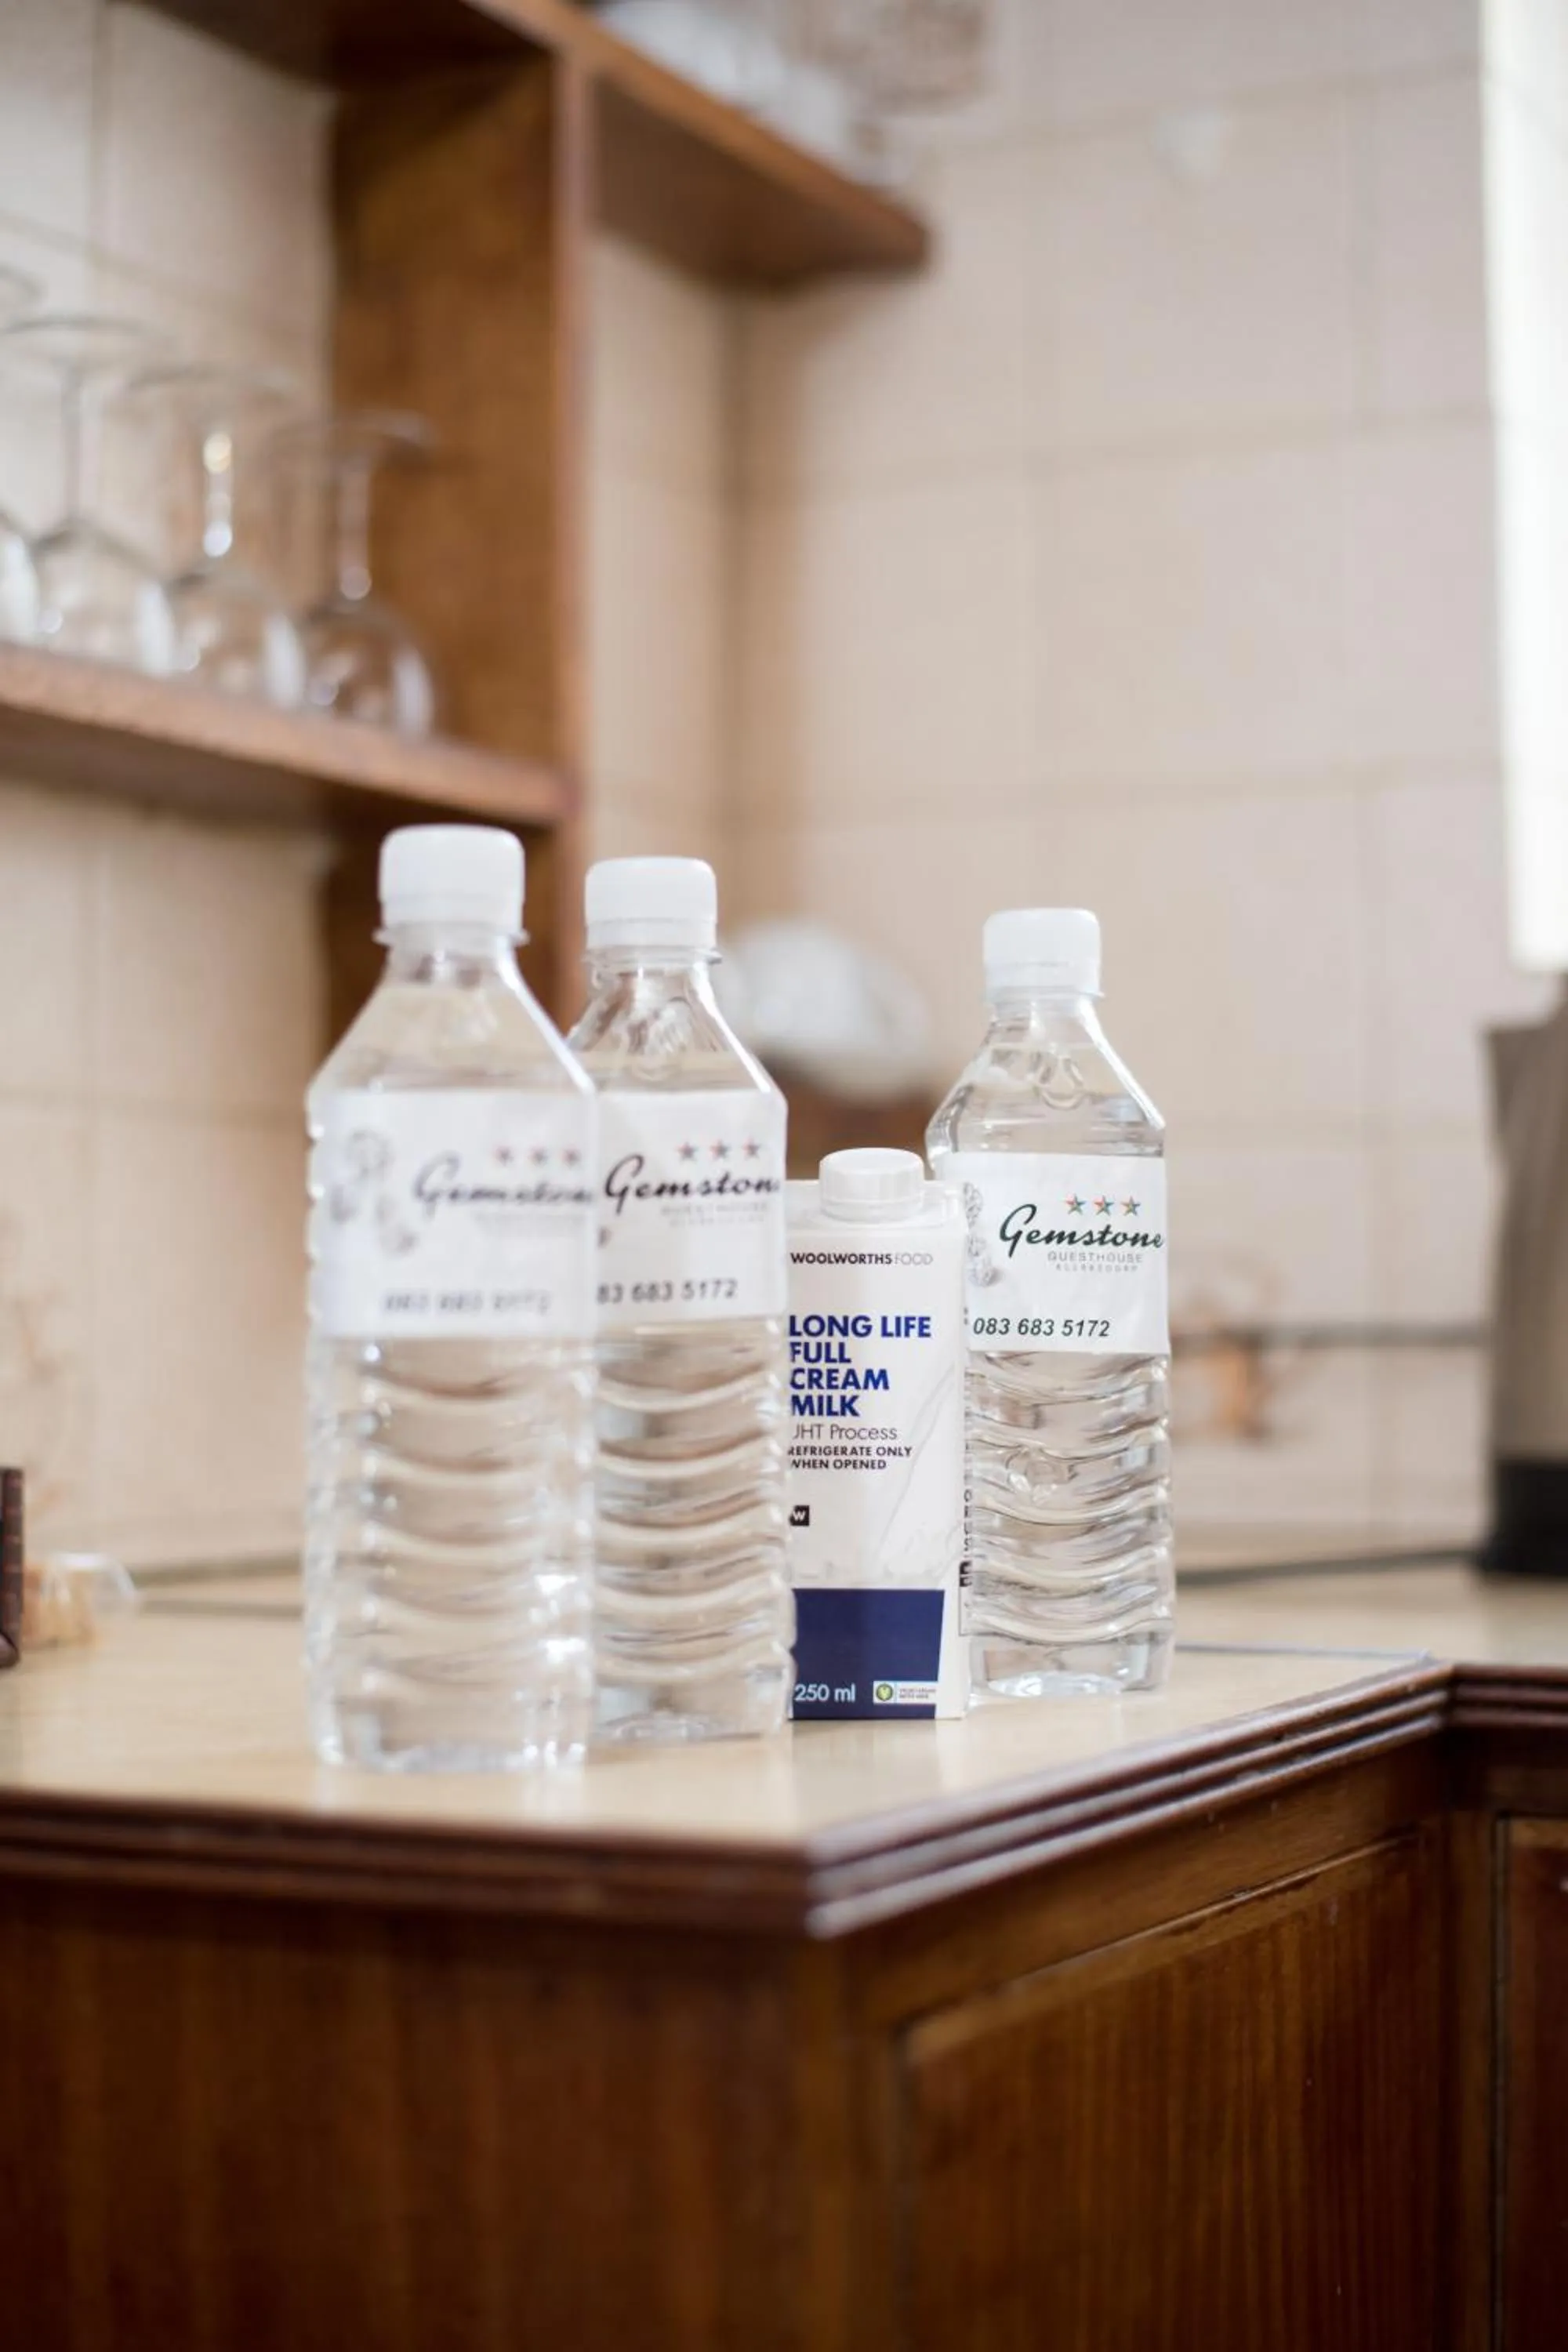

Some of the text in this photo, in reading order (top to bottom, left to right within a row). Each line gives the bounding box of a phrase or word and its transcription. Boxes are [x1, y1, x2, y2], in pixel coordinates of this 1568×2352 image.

[999, 1203, 1164, 1258] Gemstone
[597, 1283, 623, 1305] 83
[631, 1281, 673, 1302] 683
[789, 1315, 931, 1338] LONG LIFE
[973, 1318, 1111, 1338] 083 683 5172
[789, 1341, 851, 1363] FULL
[789, 1367, 889, 1390] CREAM
[791, 1395, 859, 1417] MILK
[829, 1424, 898, 1440] Process
[876, 1446, 913, 1457] ONLY
[833, 1459, 887, 1470] OPENED
[794, 1683, 855, 1702] 250 ml
